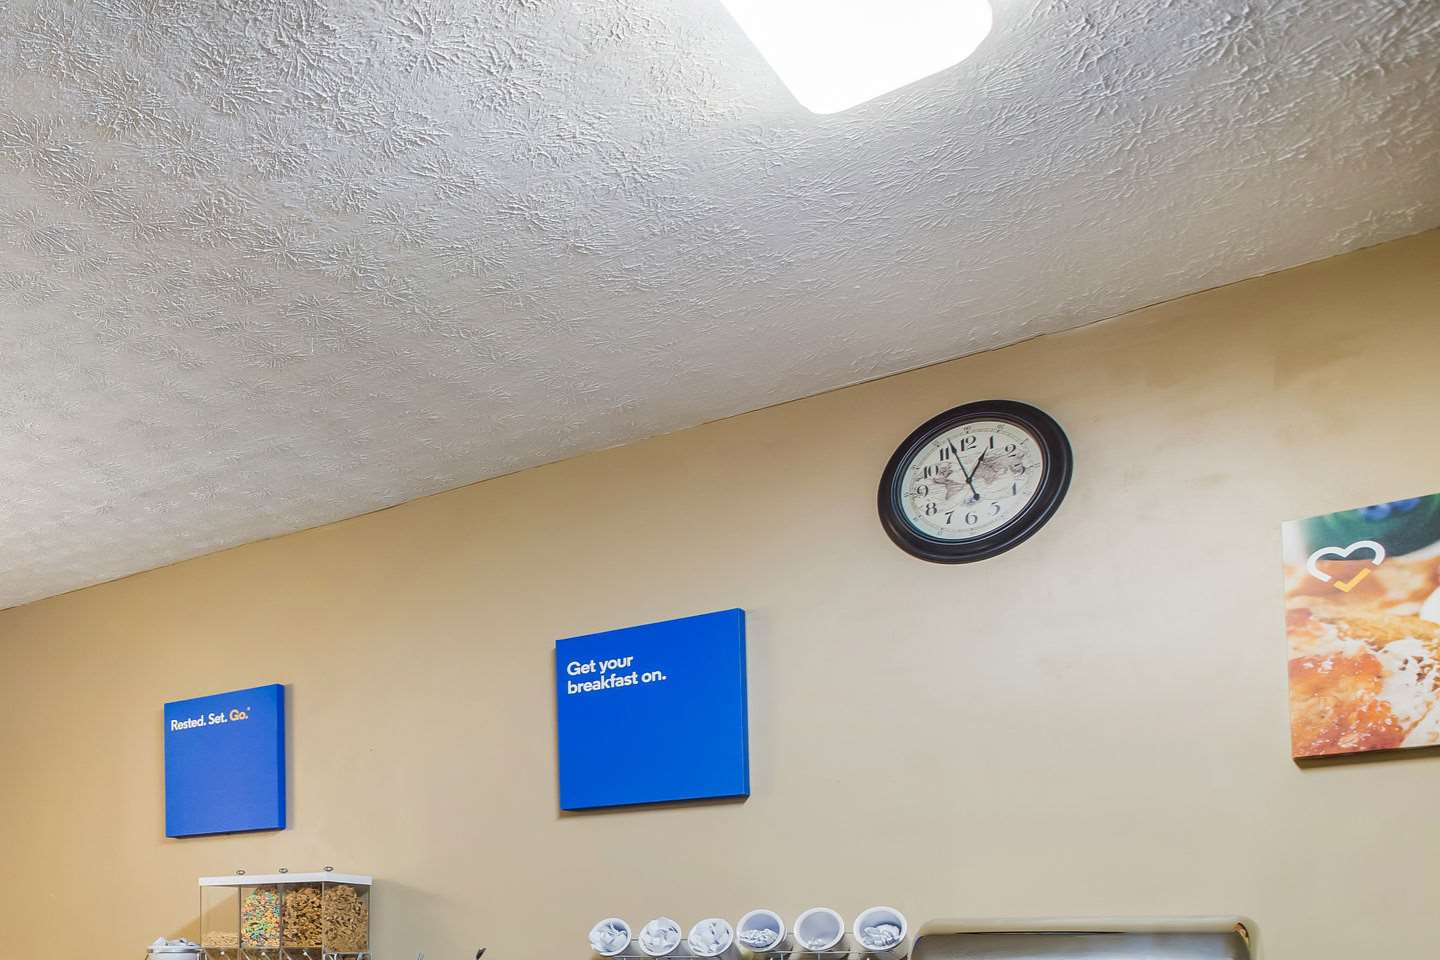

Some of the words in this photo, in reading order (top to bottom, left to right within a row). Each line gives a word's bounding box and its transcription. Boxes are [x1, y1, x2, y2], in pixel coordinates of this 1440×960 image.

[960, 435, 976, 451] 12
[939, 447, 949, 461] 11
[1005, 444, 1016, 457] 2
[923, 465, 939, 479] 10
[1013, 463, 1026, 476] 3
[917, 485, 929, 497] 9
[925, 502, 937, 516] 8
[991, 502, 1000, 515] 5
[945, 511, 954, 525] 7
[965, 512, 978, 525] 6
[567, 659, 597, 675] Get
[599, 656, 633, 674] your
[567, 671, 638, 694] breakfast
[641, 670, 667, 683] on.
[171, 714, 206, 731] Rested.
[208, 712, 227, 725] Set.
[229, 709, 249, 721] Go.
